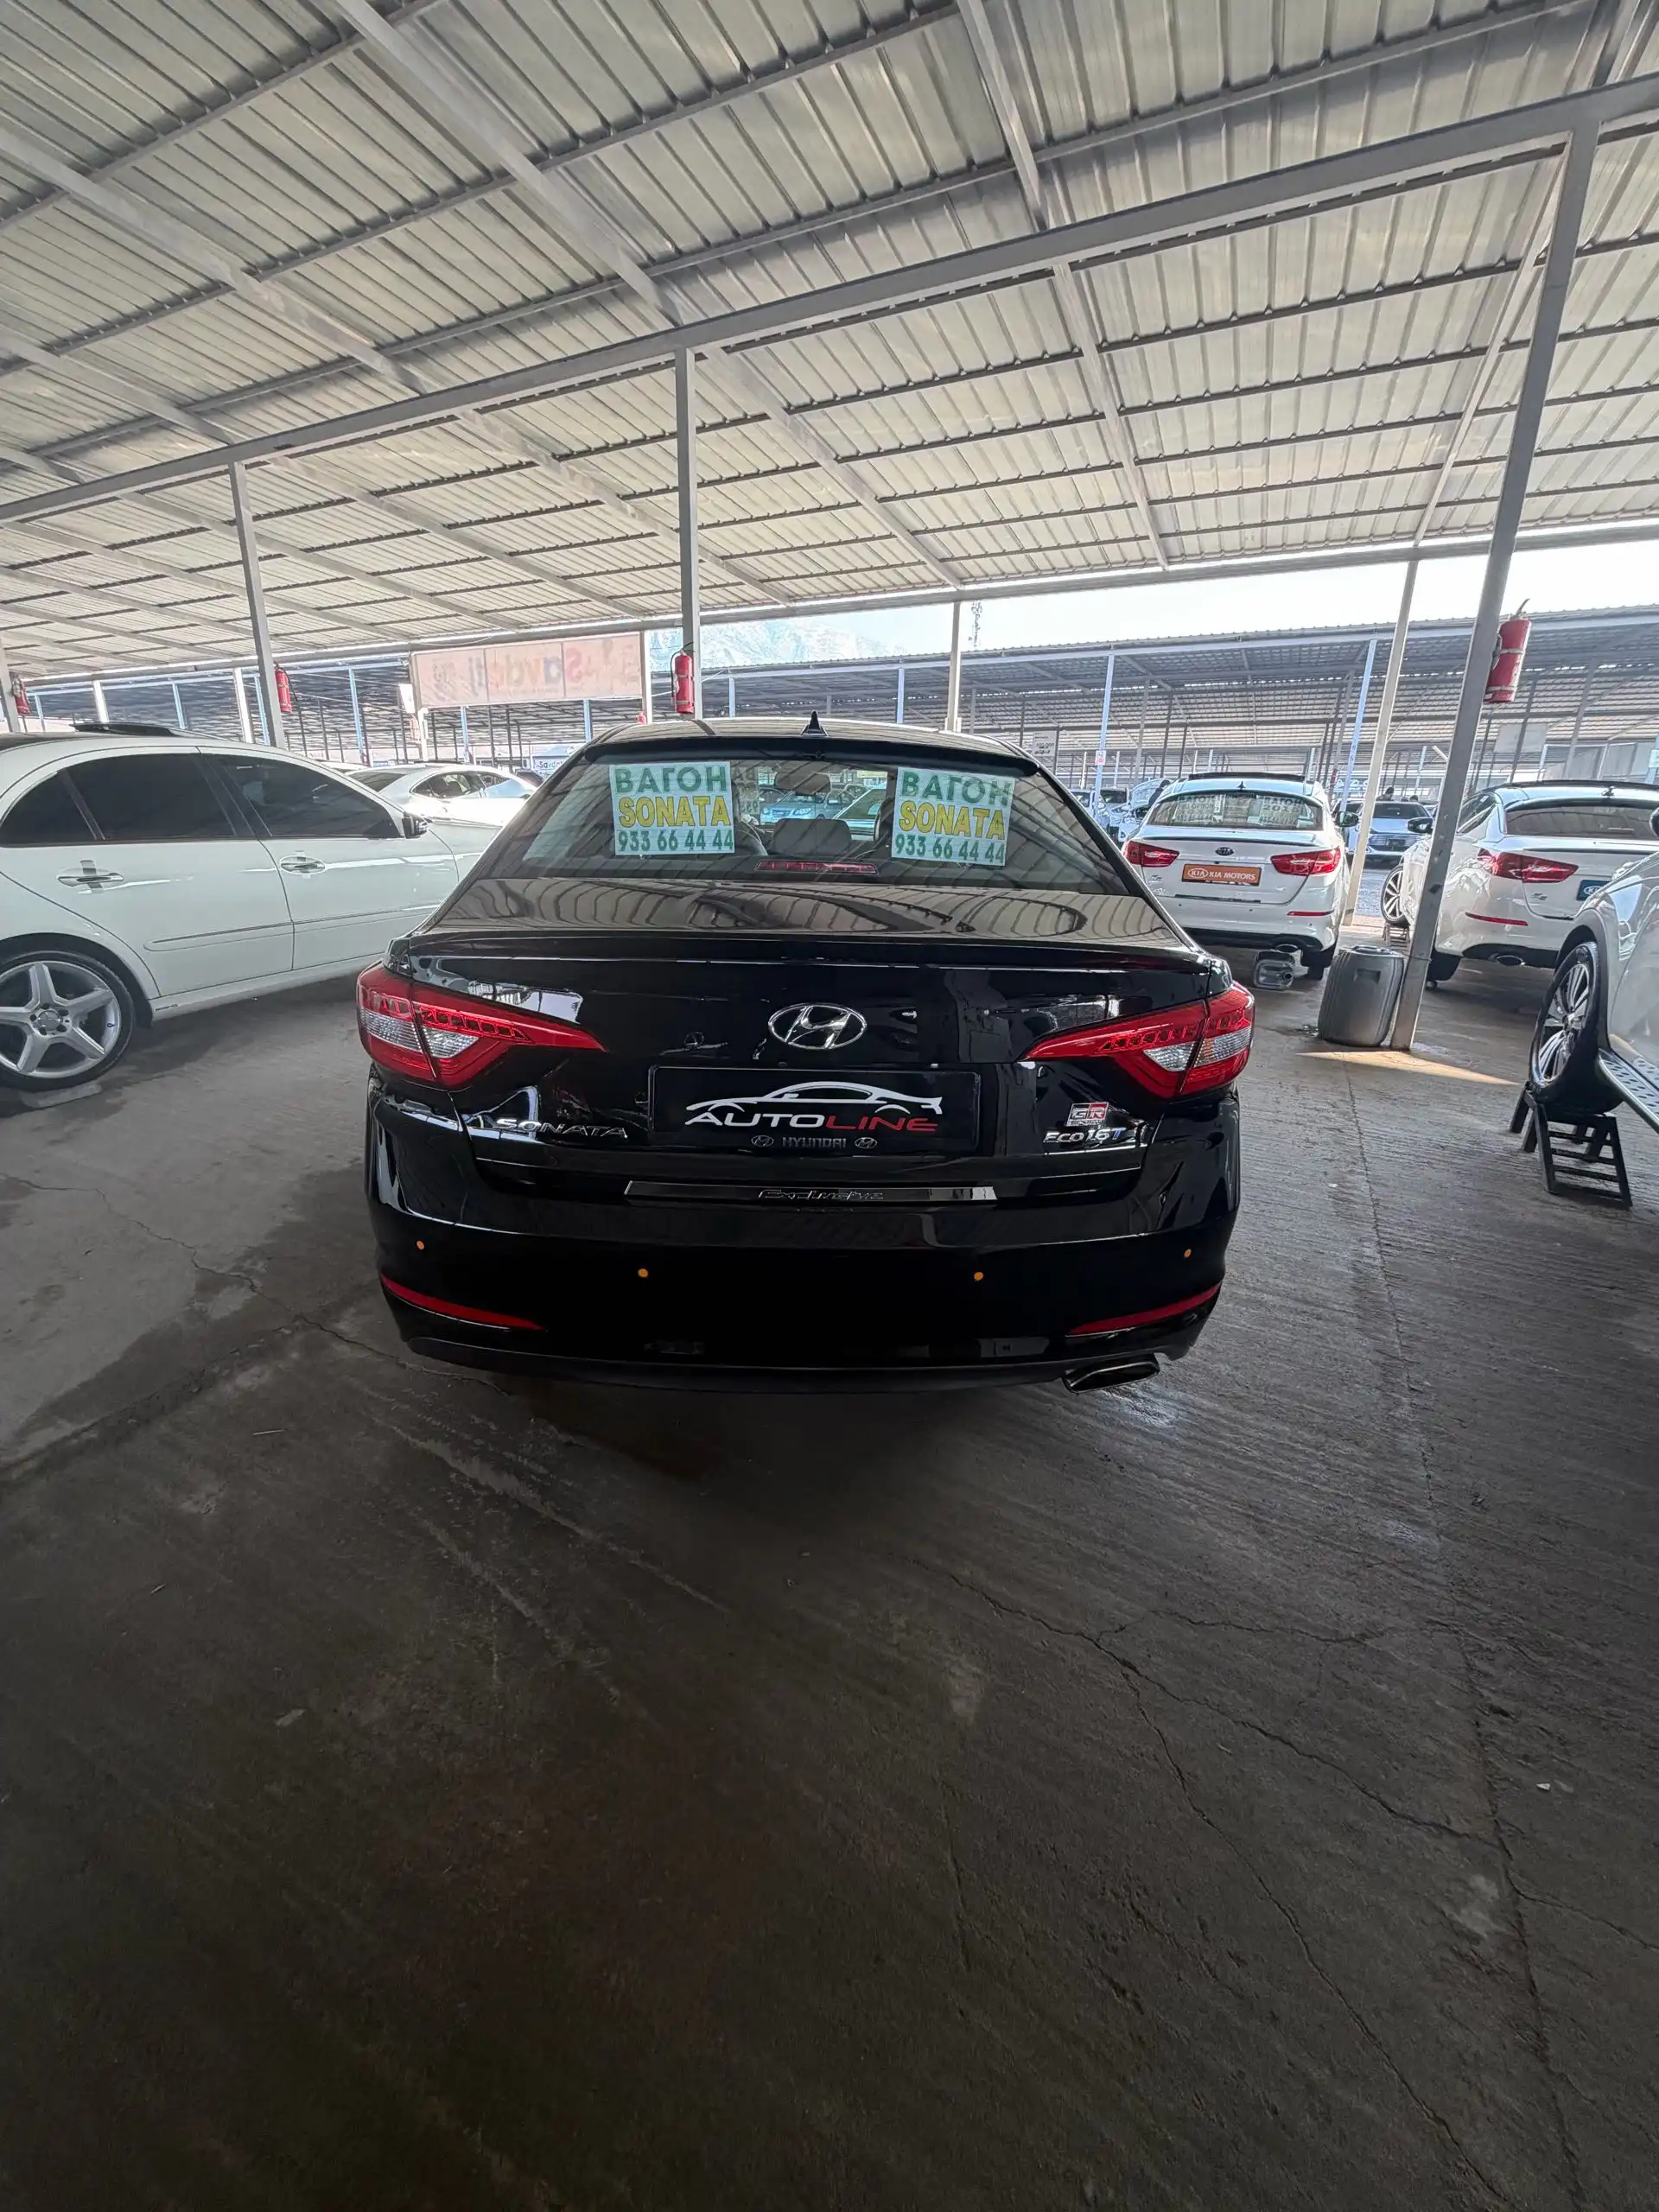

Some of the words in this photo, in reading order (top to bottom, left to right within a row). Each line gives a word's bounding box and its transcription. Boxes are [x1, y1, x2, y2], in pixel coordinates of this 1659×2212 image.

[615, 766, 727, 792] ВАГОН
[901, 772, 1010, 806] ВАГОН
[619, 796, 731, 828] SONATA
[899, 800, 1005, 840] SONATA
[619, 830, 650, 851] 933
[658, 830, 678, 850] 66
[684, 830, 705, 850] 44
[712, 830, 733, 849] 44
[895, 834, 925, 856] 933
[933, 836, 952, 858] 66
[958, 841, 978, 861] 44
[985, 843, 1004, 862] 44
[493, 1118, 628, 1138] SONATA
[684, 1112, 938, 1132] AUTOLINE
[782, 1137, 846, 1147] HYUNDAI
